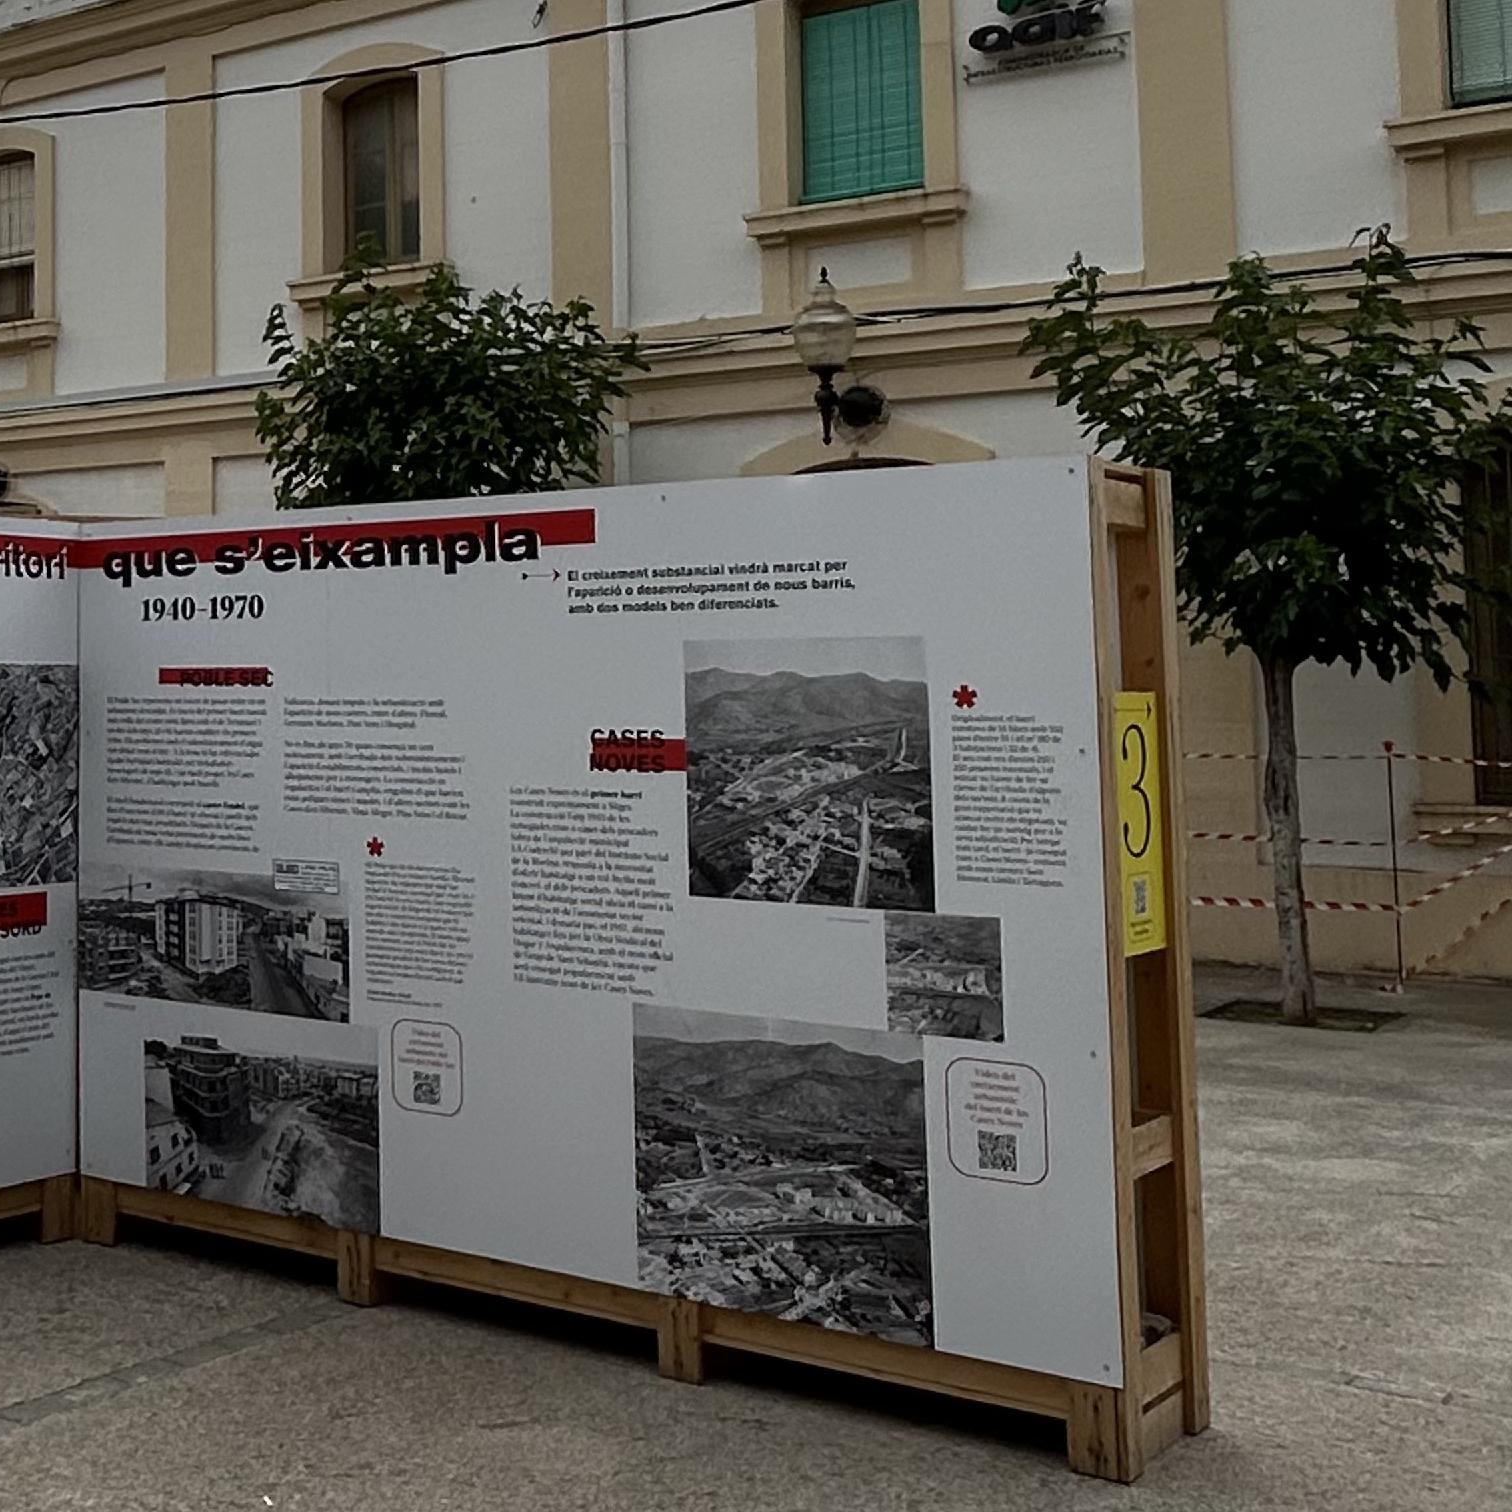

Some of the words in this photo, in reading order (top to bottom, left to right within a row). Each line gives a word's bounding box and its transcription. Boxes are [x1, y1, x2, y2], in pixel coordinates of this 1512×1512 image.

[103, 545, 197, 588] que
[215, 522, 540, 574] s'eixampla
[773, 561, 821, 573] marcat
[824, 562, 847, 574] per
[753, 581, 770, 591] de
[774, 581, 807, 590] nous
[140, 594, 265, 624] 1940-1970
[569, 603, 594, 613] amb
[597, 603, 619, 613] dos
[671, 600, 695, 611] ben
[180, 671, 235, 687] POBLE
[590, 729, 665, 748] CASES
[589, 753, 666, 773] NOVES
[1122, 724, 1152, 858] 3
